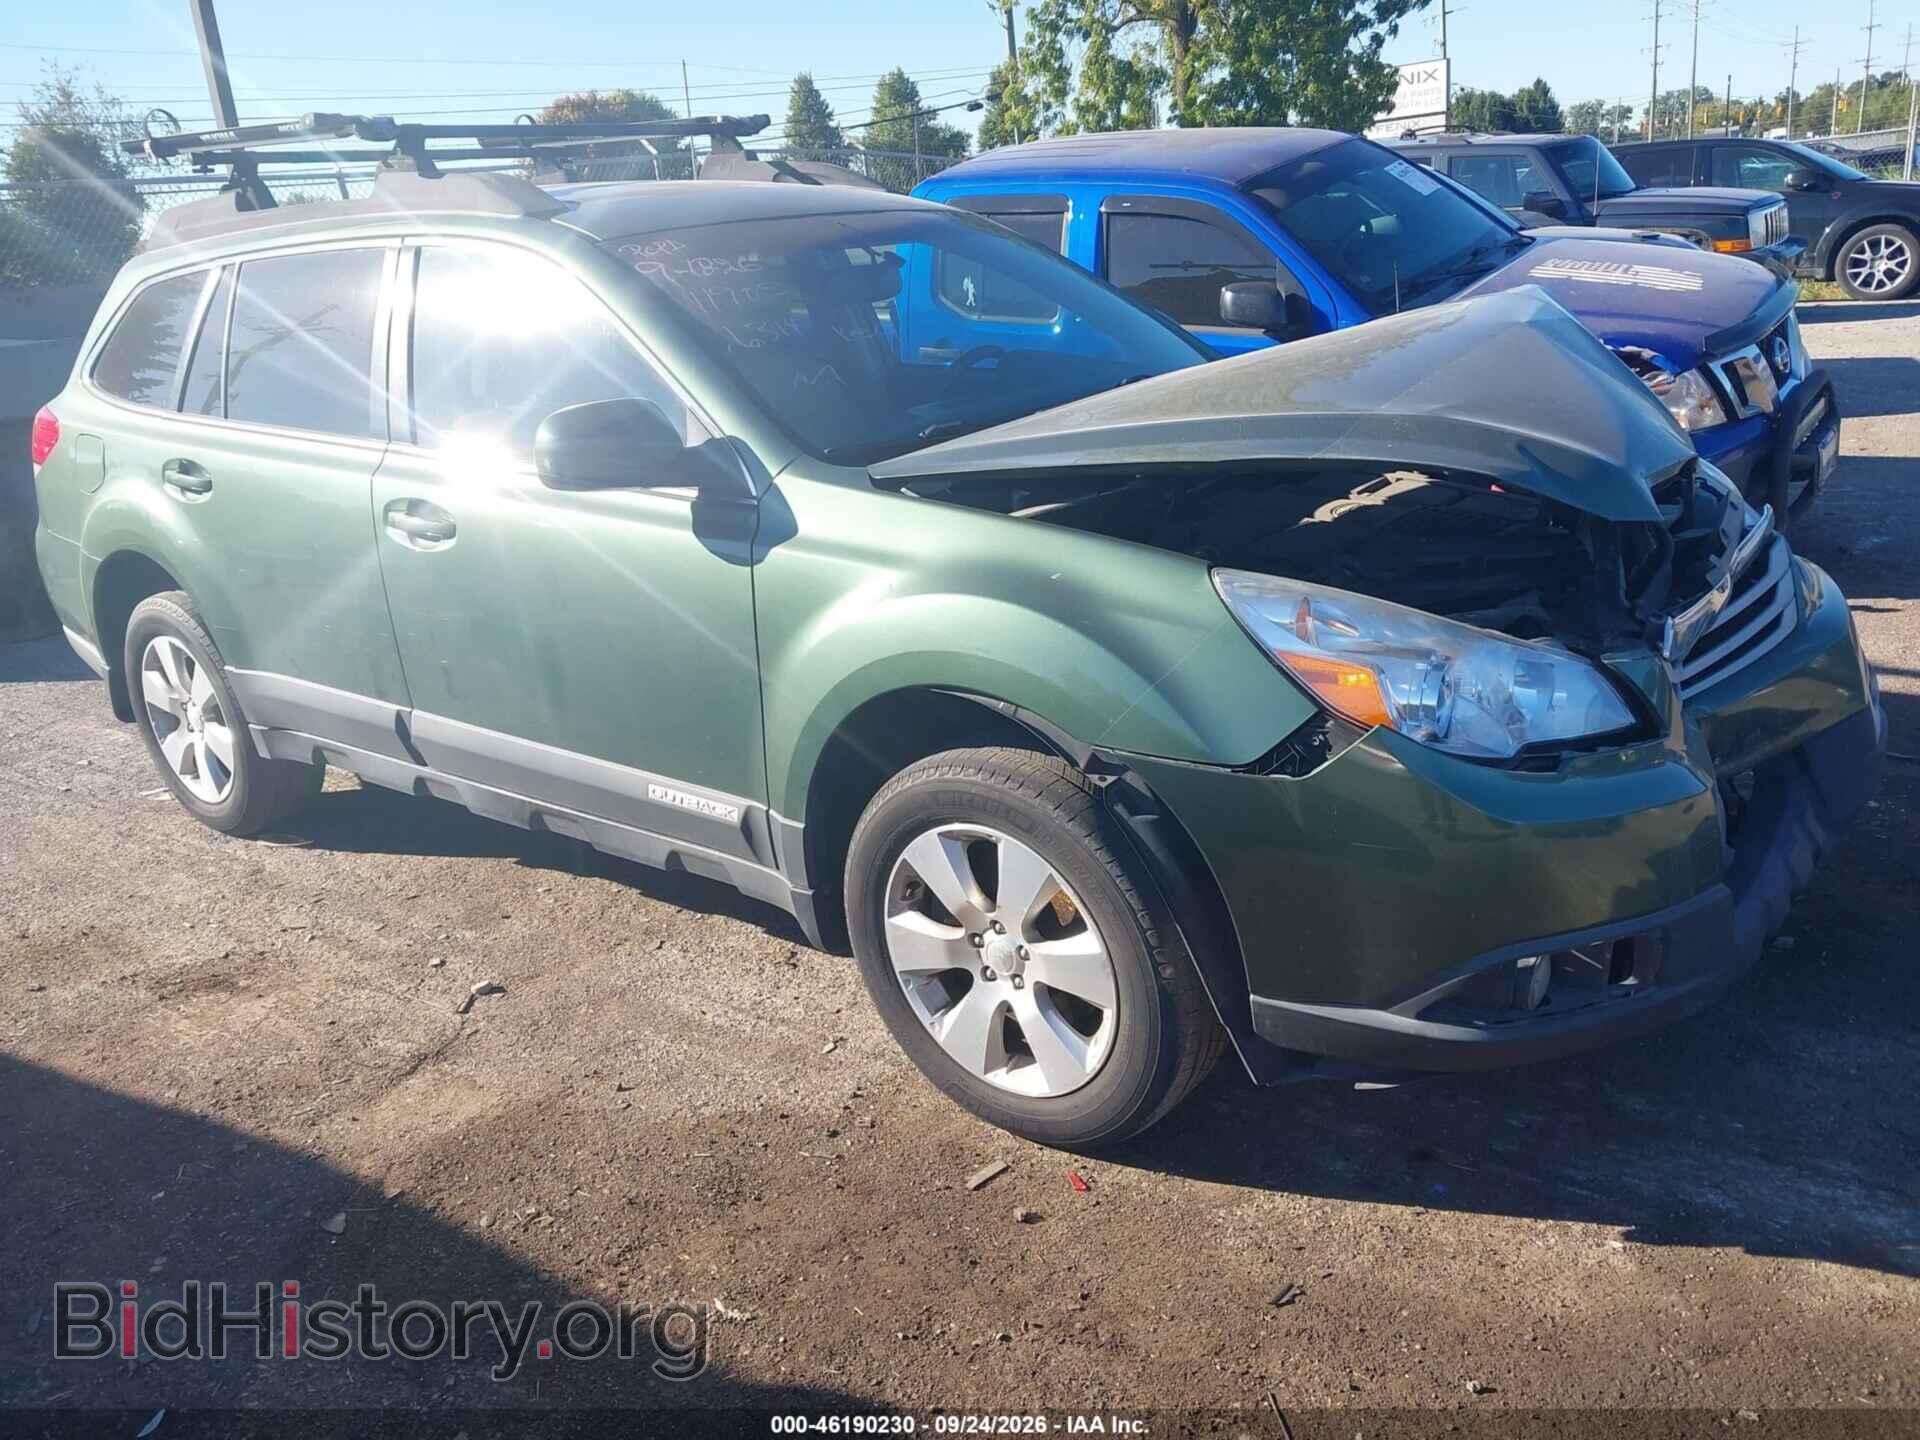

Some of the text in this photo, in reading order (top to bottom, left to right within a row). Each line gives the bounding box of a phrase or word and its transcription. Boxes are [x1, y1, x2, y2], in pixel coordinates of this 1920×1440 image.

[1399, 68, 1439, 85] NIX
[1376, 119, 1422, 133] FENIX
[648, 784, 738, 822] OUTBACK
